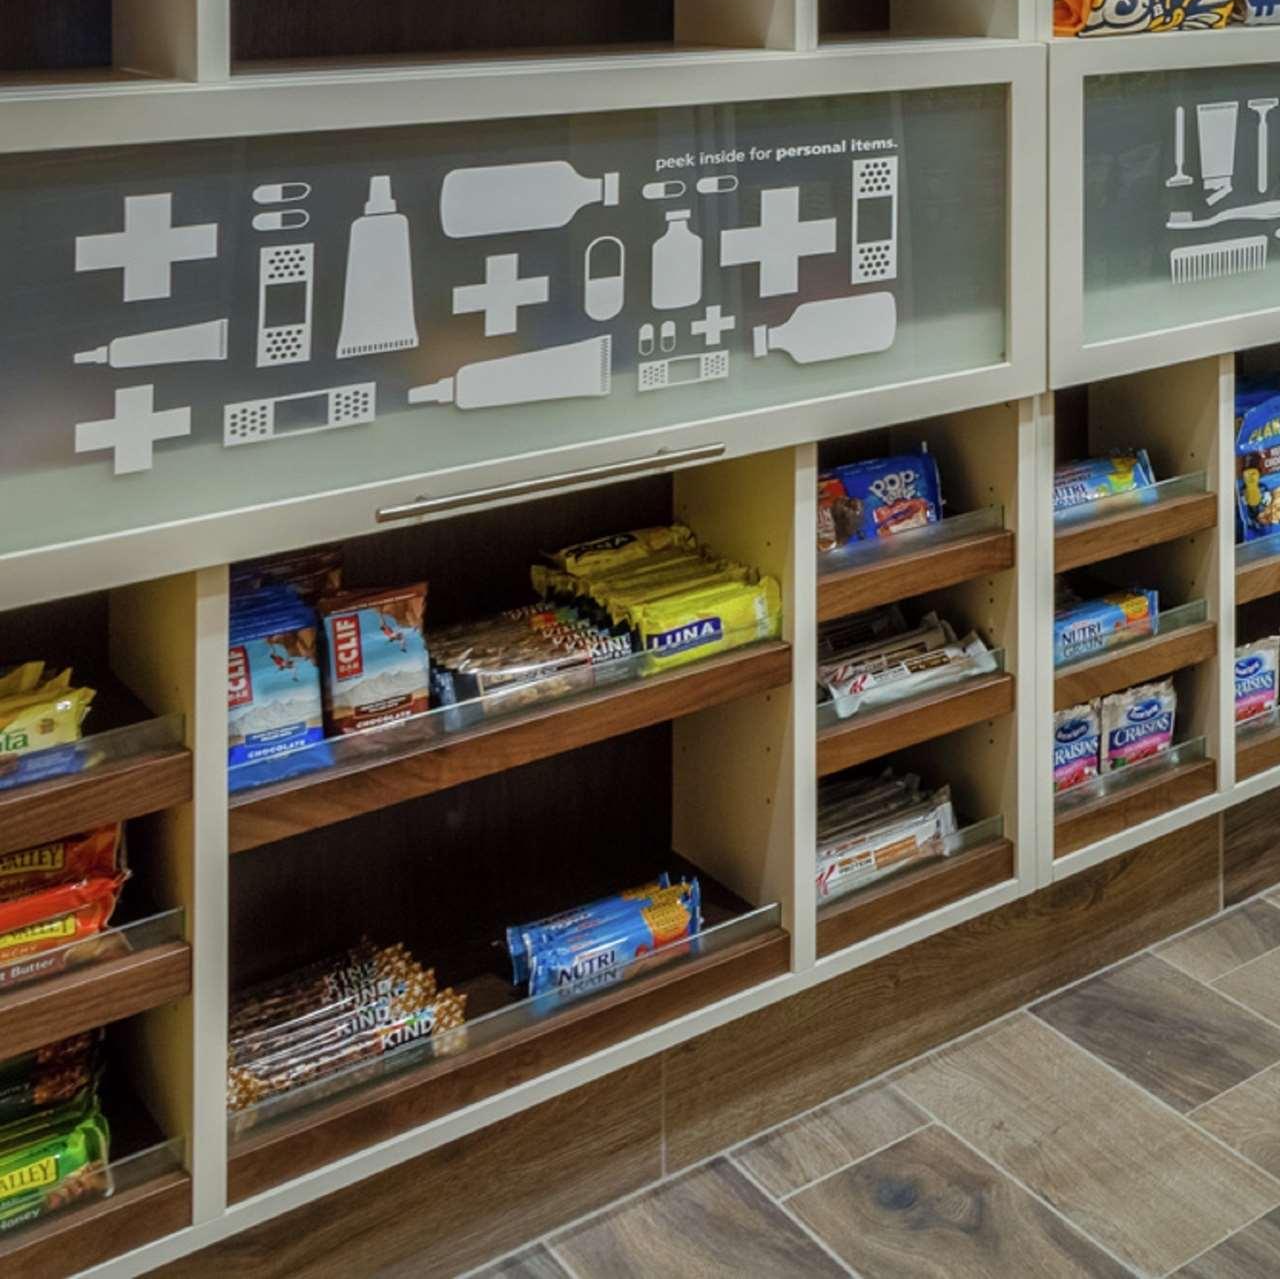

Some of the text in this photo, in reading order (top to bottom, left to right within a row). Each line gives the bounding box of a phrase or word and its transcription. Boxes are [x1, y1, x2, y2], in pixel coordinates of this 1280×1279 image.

[656, 136, 899, 172] peek inside for personal items.
[651, 621, 717, 652] LUNA
[1062, 622, 1101, 647] NUTRI
[1234, 671, 1274, 697] RAISINS
[1113, 712, 1173, 747] CRAISINS
[1053, 736, 1099, 766] RAISINS
[10, 957, 56, 978] Butter
[557, 949, 616, 987] NUTRI
[382, 1017, 437, 1050] KIND
